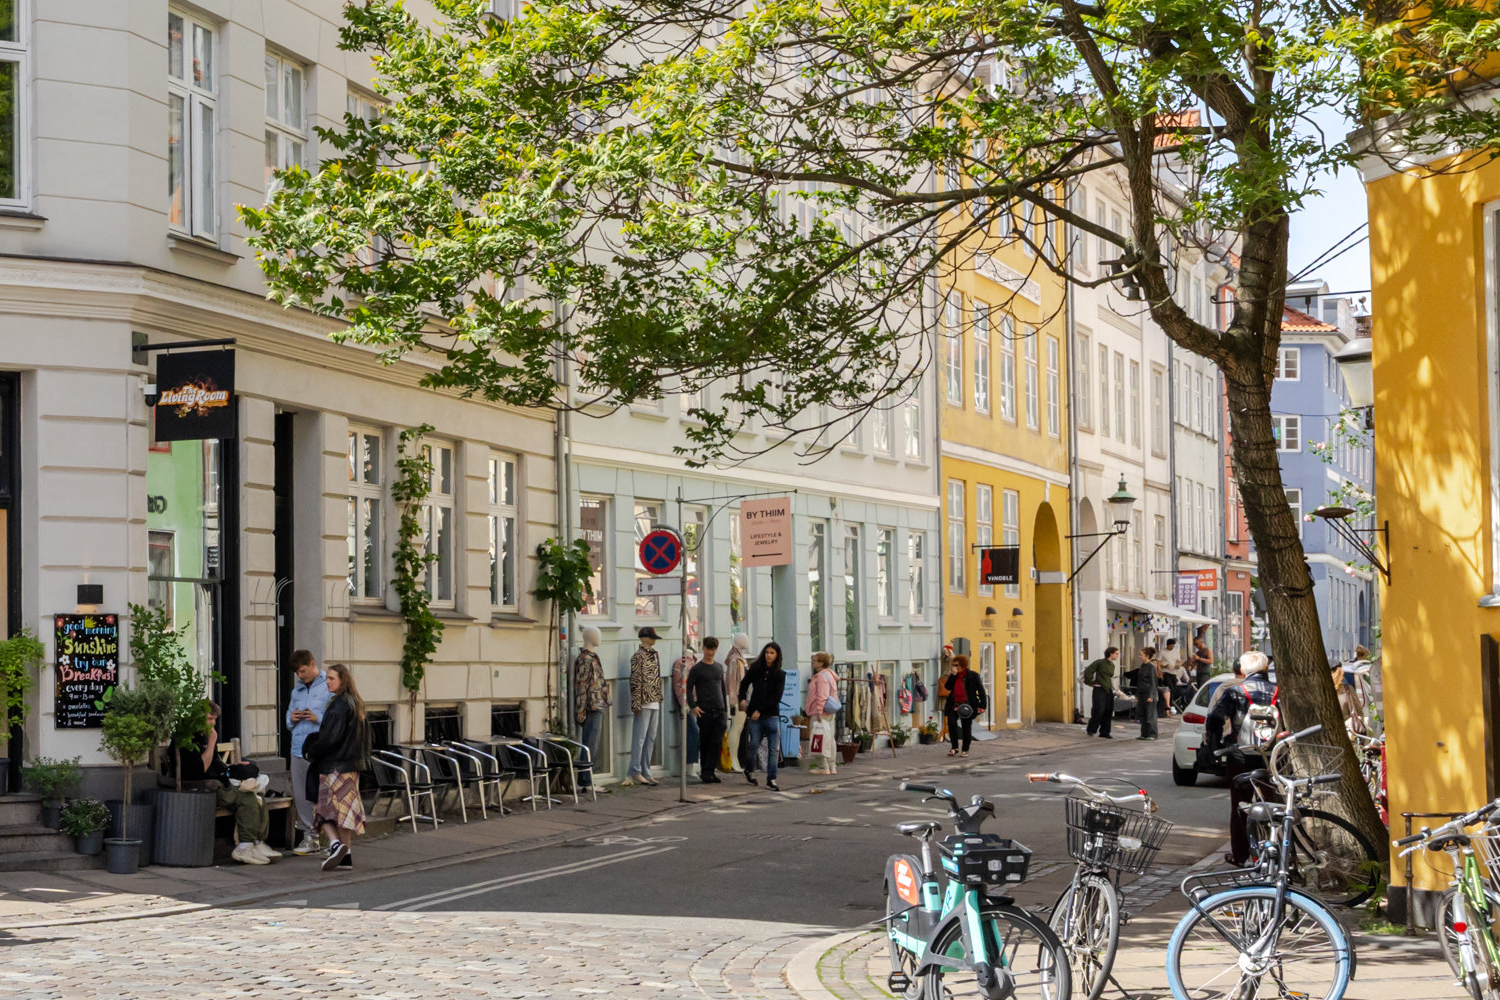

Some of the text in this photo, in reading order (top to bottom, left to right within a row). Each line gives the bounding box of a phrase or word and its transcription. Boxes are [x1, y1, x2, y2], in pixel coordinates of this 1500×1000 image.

[160, 390, 227, 405] Living Room
[746, 508, 785, 519] BY THIIM
[64, 619, 85, 635] good
[64, 636, 117, 655] Sunshine
[74, 657, 89, 671] try
[66, 682, 103, 693] every day
